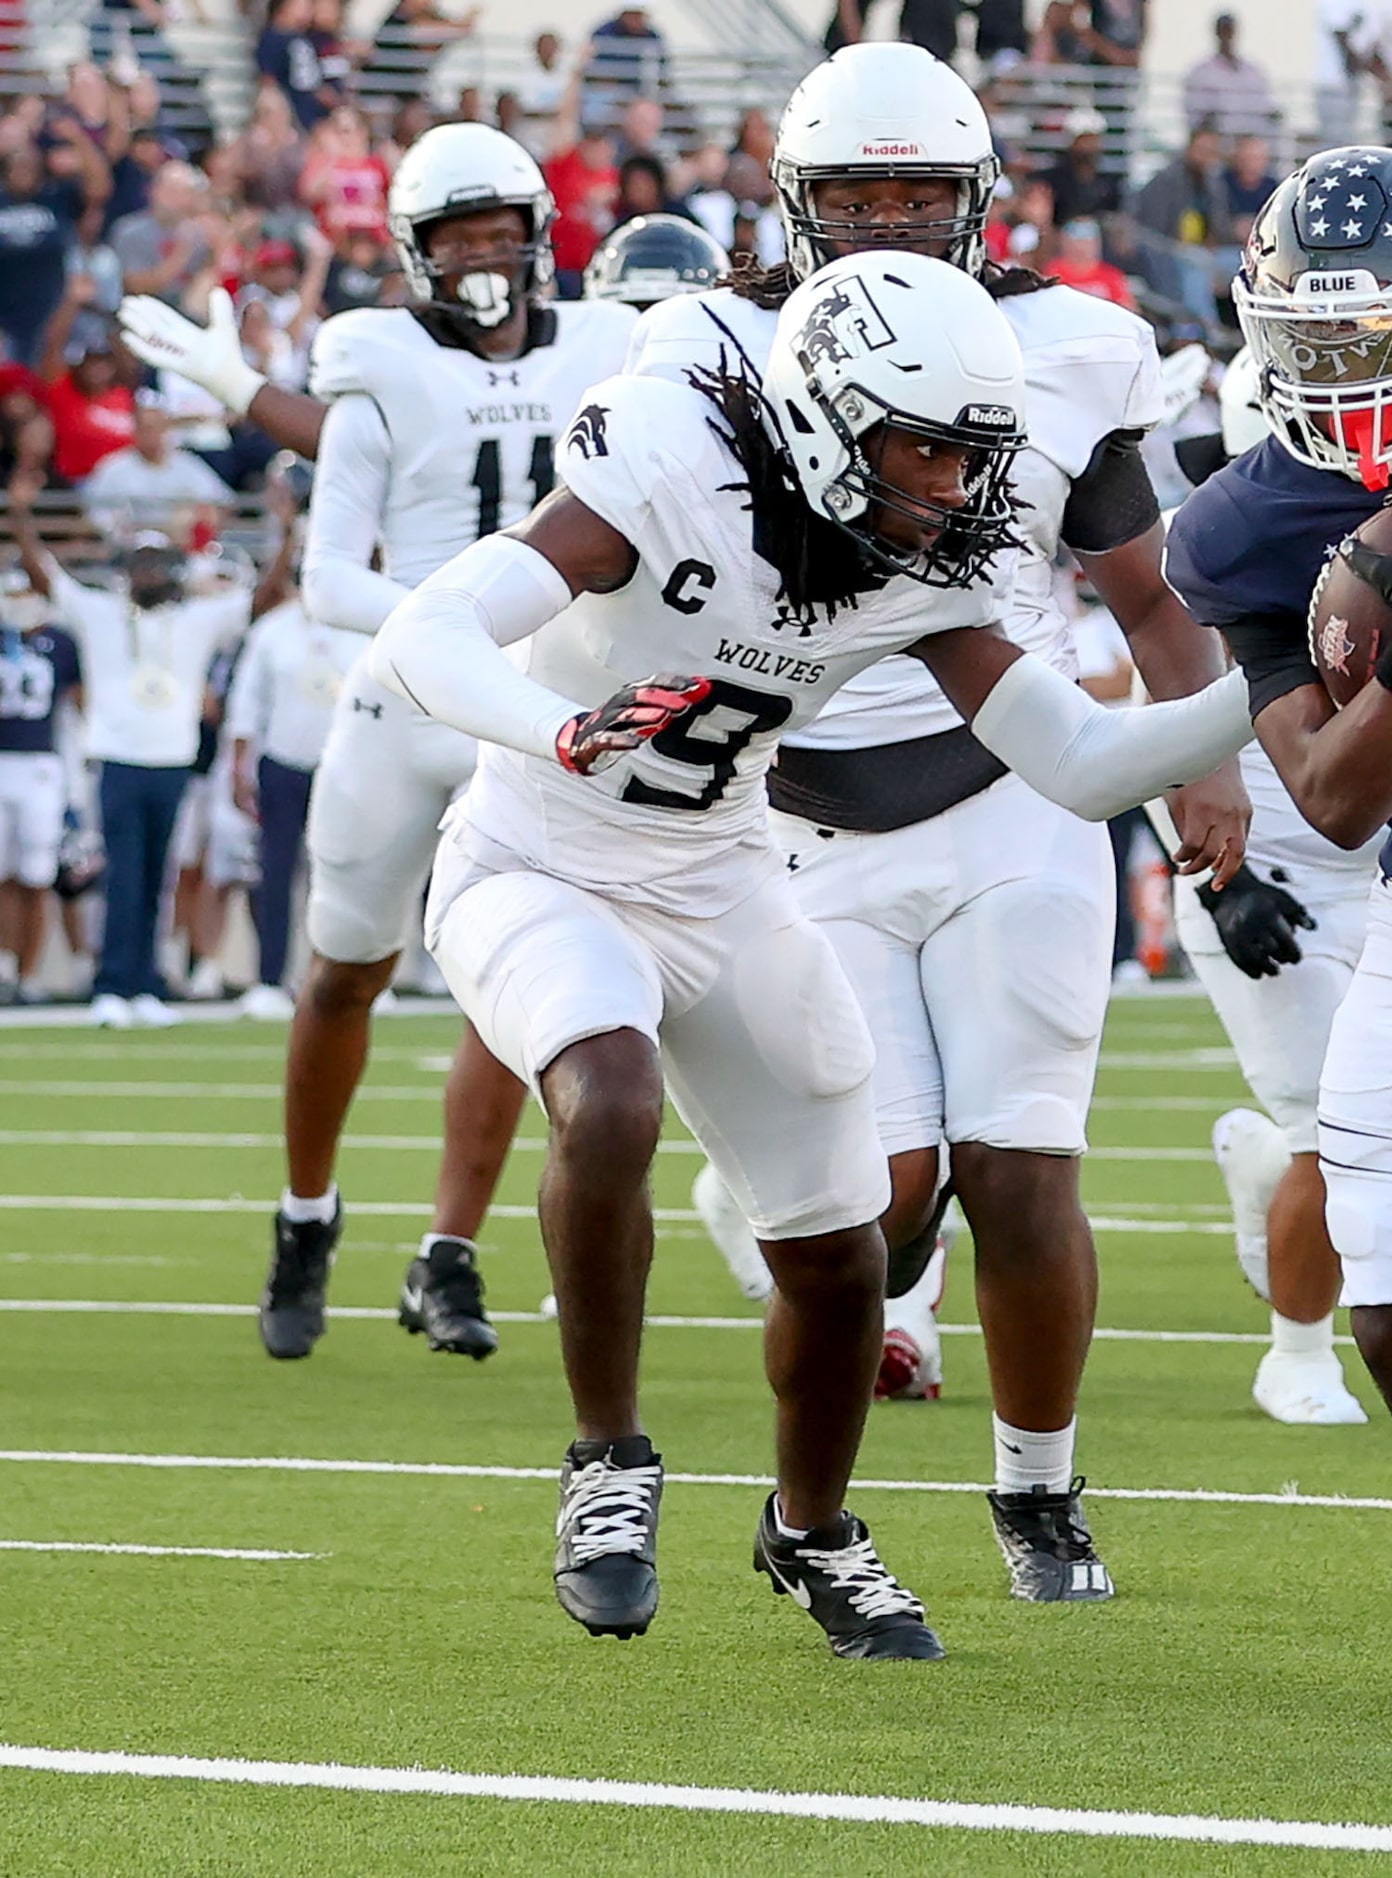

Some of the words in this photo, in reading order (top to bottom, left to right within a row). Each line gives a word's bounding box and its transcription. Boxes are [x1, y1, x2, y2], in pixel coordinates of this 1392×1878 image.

[863, 144, 918, 155] Riddell
[1310, 276, 1356, 292] BLUE
[465, 403, 552, 425] WOLVES
[968, 406, 1015, 425] Riddell
[470, 433, 555, 540] 11
[661, 558, 717, 615] C
[714, 638, 826, 685] WOLVES
[621, 677, 794, 812] 9
